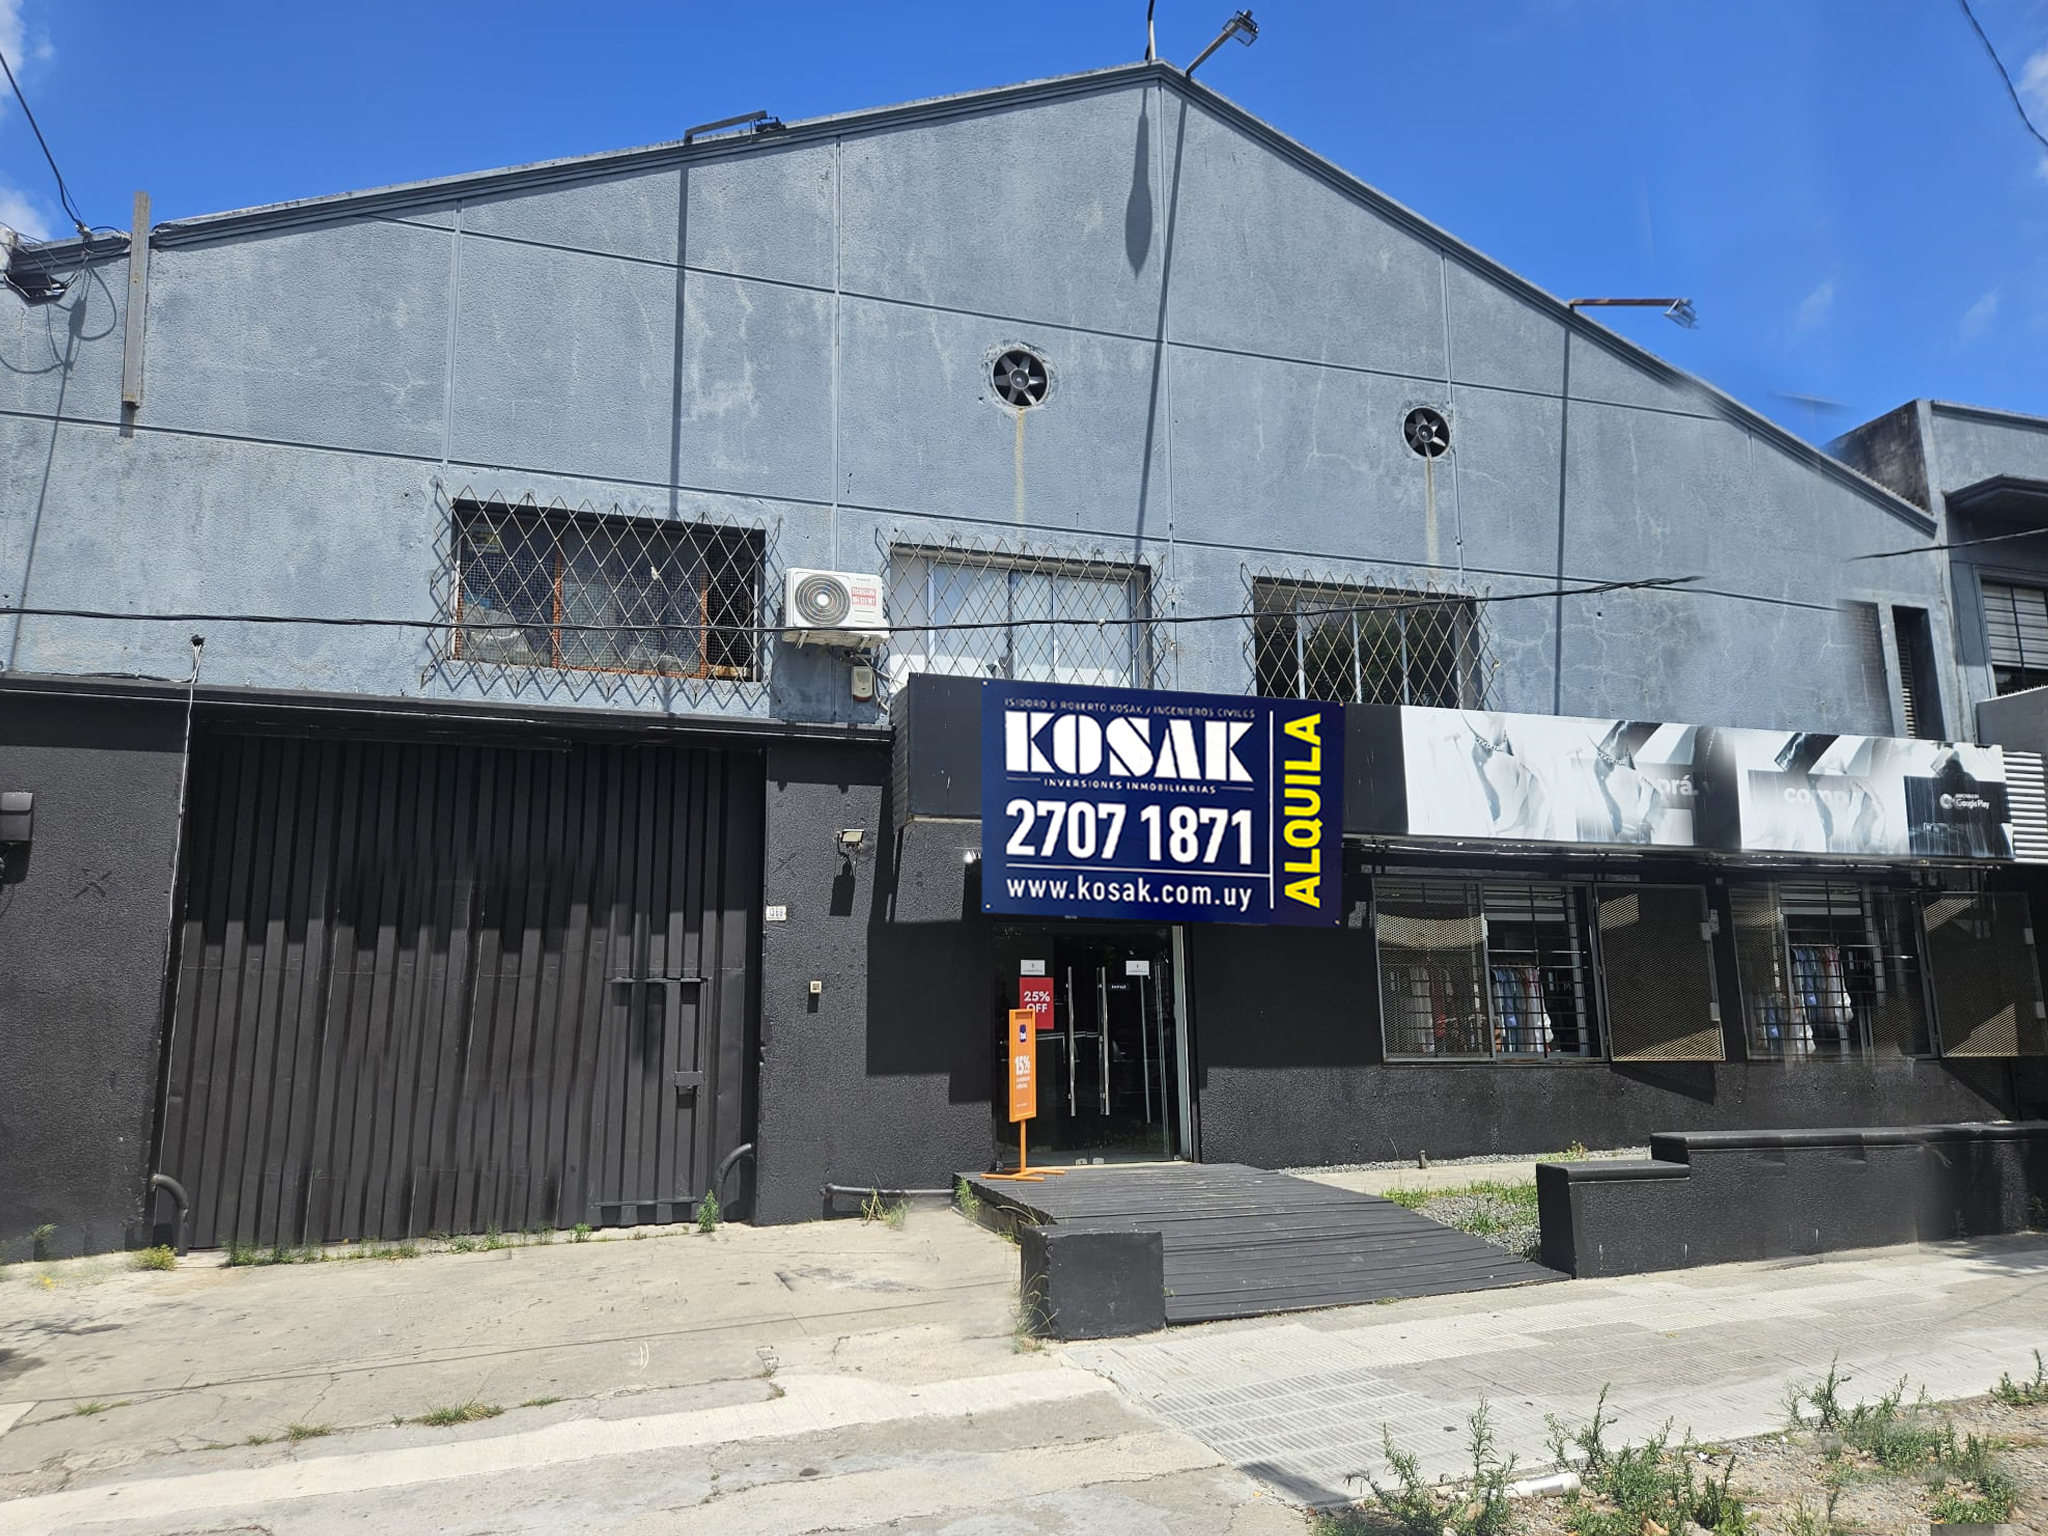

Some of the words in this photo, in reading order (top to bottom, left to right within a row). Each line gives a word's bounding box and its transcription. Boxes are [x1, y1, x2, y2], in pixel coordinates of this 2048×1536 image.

[1005, 698, 1047, 708] ISIDORO
[1060, 701, 1107, 712] ROBERTO
[1110, 704, 1142, 715] KOSAK
[1154, 706, 1214, 717] INGENIEROS
[1218, 708, 1256, 719] CIVILES
[1005, 711, 1254, 782] KOSAK
[1044, 779, 1122, 790] INVERSIONES
[1127, 781, 1217, 794] INMOBILIARIAS
[1284, 713, 1322, 908] ALQUILA
[1006, 799, 1126, 859] 2707
[1140, 805, 1251, 865] 1871
[1007, 875, 1252, 912] www.kosak.com.uy
[1023, 991, 1051, 1002] 25%
